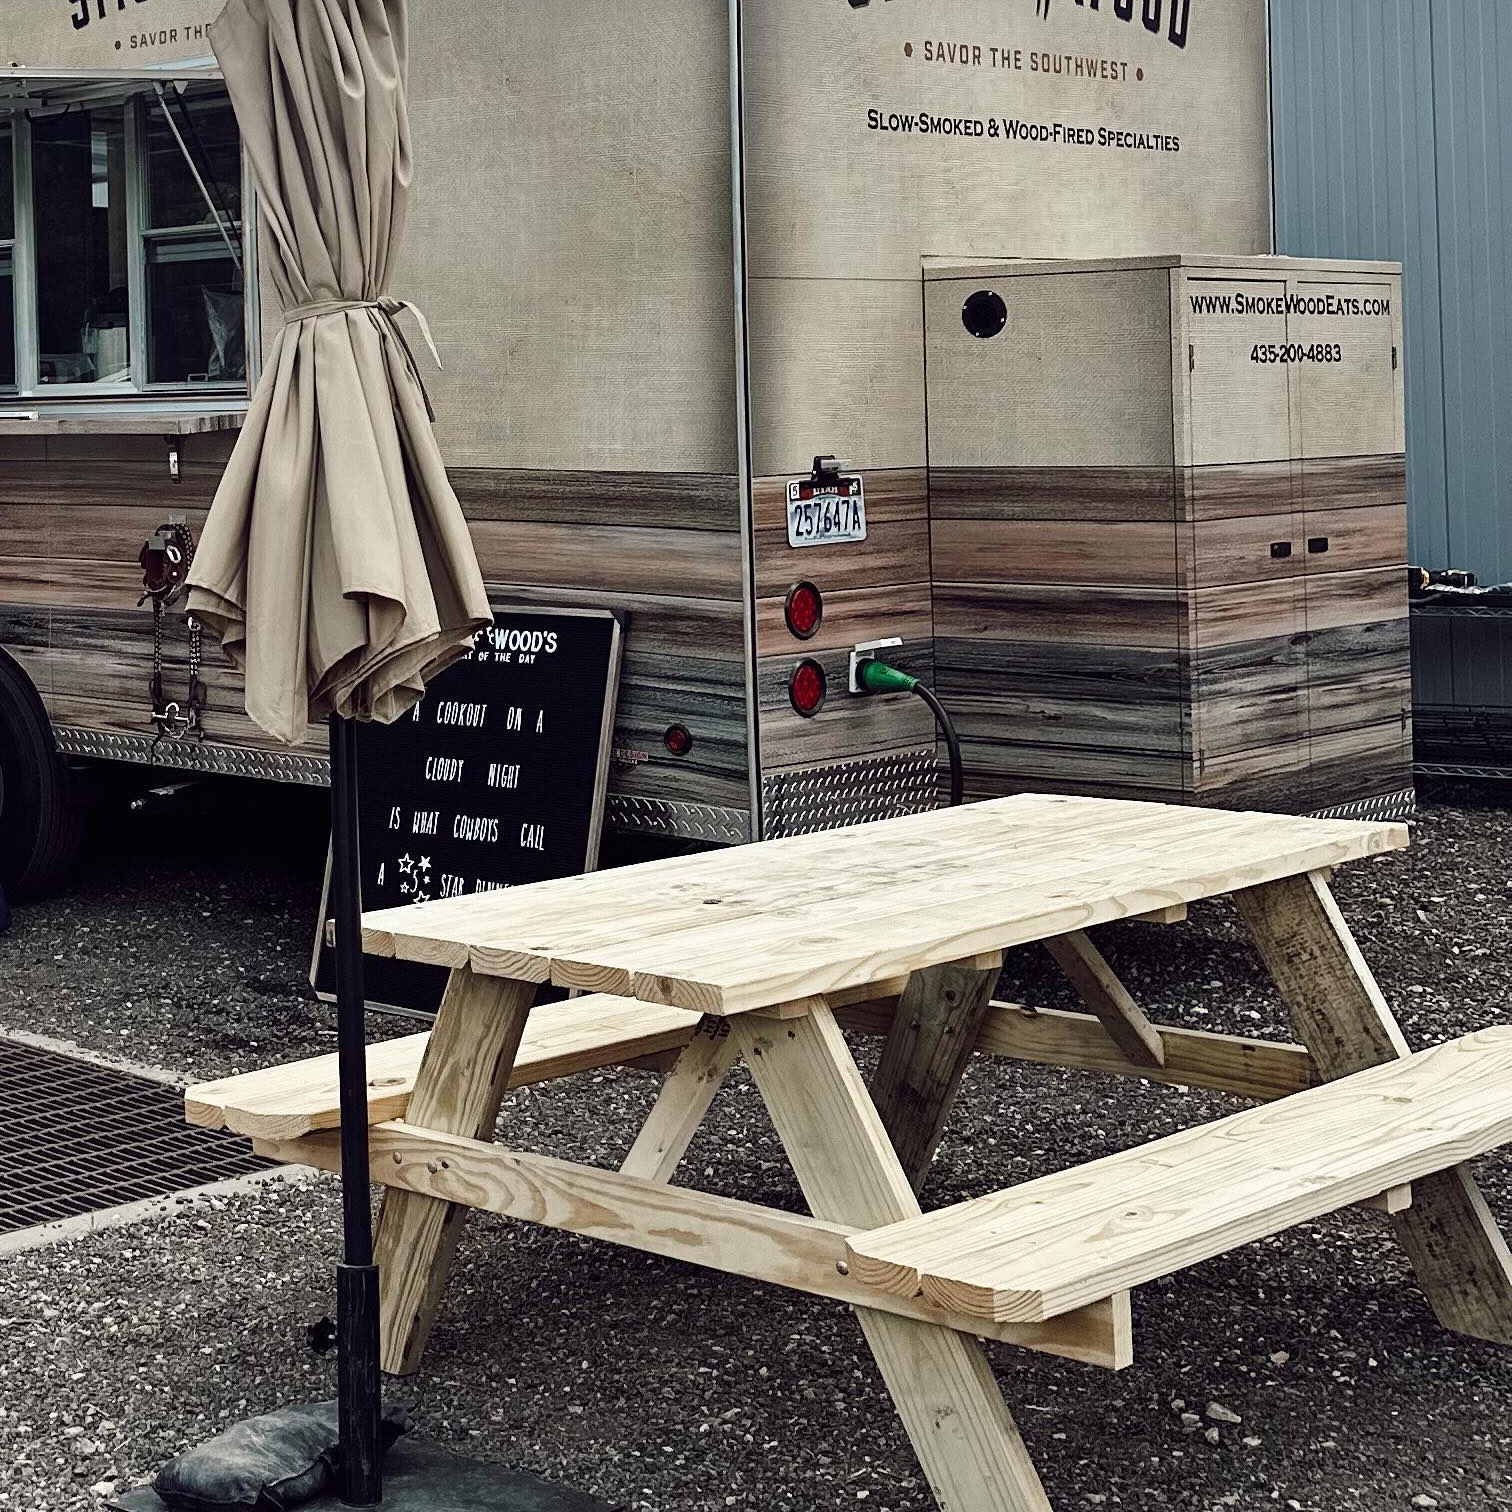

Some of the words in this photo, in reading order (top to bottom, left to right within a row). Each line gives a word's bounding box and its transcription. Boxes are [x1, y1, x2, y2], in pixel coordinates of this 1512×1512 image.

[130, 30, 178, 49] SAVOR
[923, 41, 982, 67] SAVOR
[989, 48, 1023, 71] THE
[1030, 54, 1128, 82] SOUTHWEST
[988, 119, 1000, 139] &
[1250, 343, 1342, 364] 435-200-4883
[795, 500, 860, 536] 257647A
[478, 652, 489, 661] OF
[495, 653, 511, 662] THE
[519, 654, 535, 664] DAY
[413, 701, 420, 721] A
[436, 701, 487, 728] COOKOUT
[507, 706, 522, 731] ON
[536, 709, 543, 733] A
[426, 756, 464, 783] CLOUDY
[488, 763, 520, 789] NIGHT
[389, 807, 400, 830] IS
[413, 811, 440, 836] WHAT
[454, 815, 498, 843] COWBOYS
[520, 823, 545, 851] CALL
[377, 862, 385, 885] A
[440, 874, 464, 897] STAR
